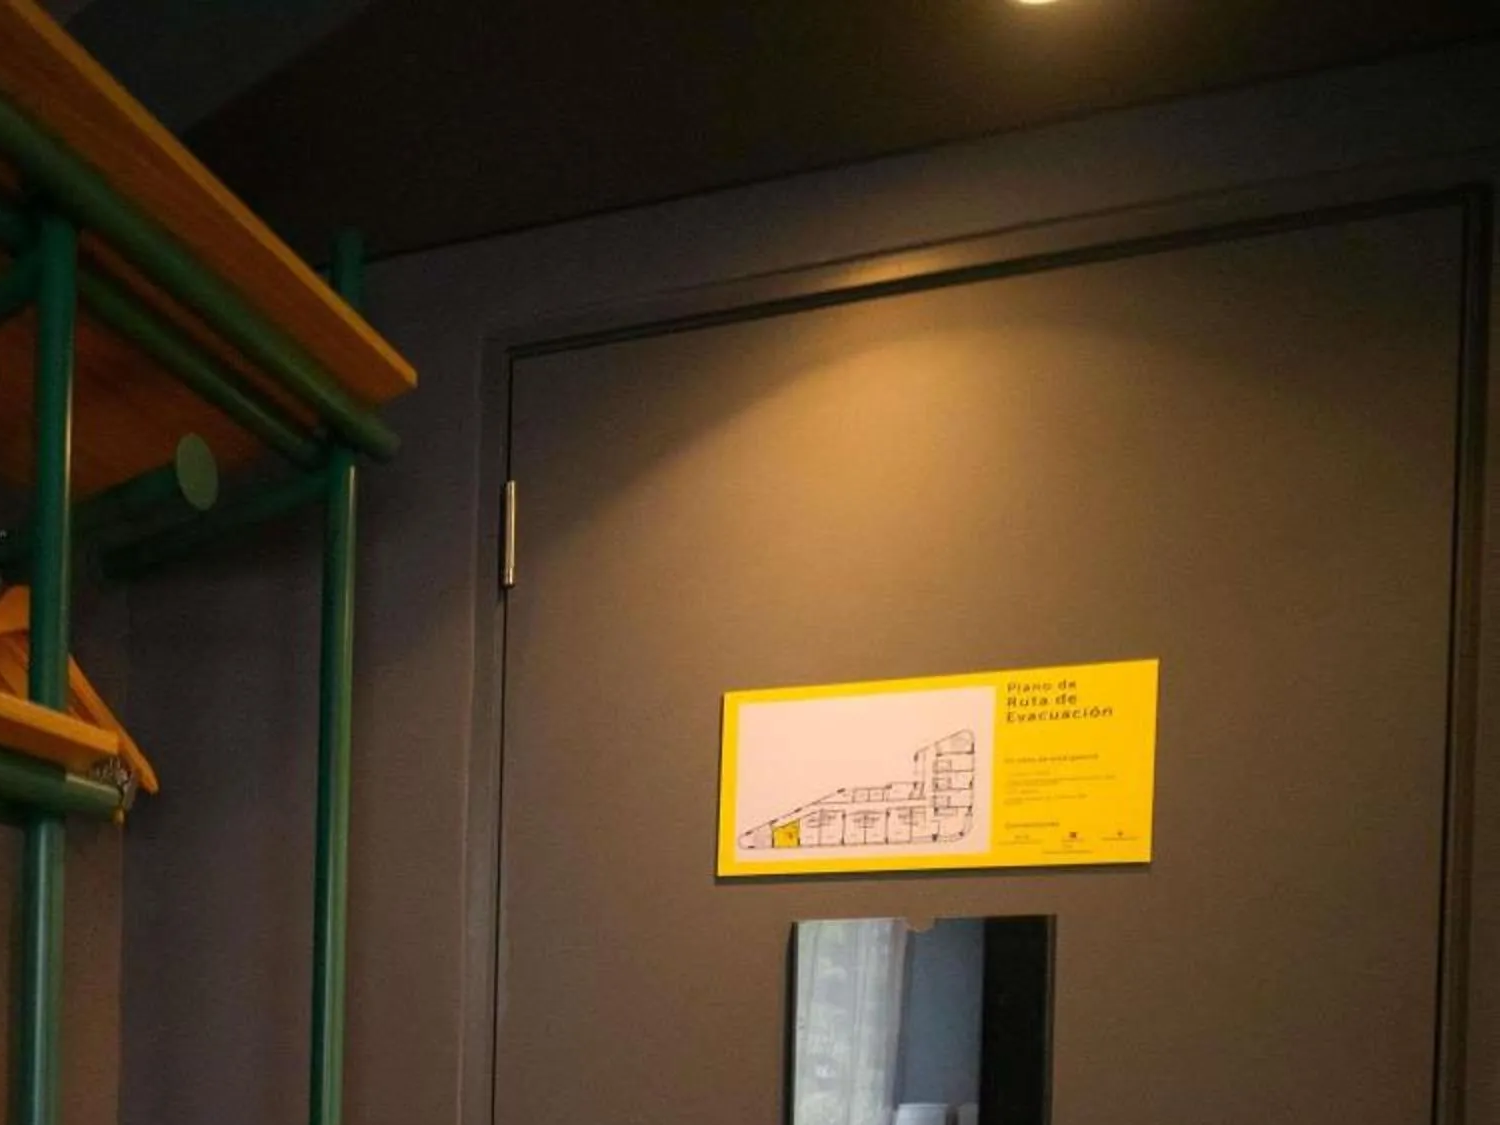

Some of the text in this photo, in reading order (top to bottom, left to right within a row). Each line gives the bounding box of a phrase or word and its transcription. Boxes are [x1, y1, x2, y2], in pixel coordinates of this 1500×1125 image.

[1007, 679, 1077, 693] Plano de
[1007, 693, 1077, 708] Ruta de
[1007, 705, 1114, 723] Evacuación
